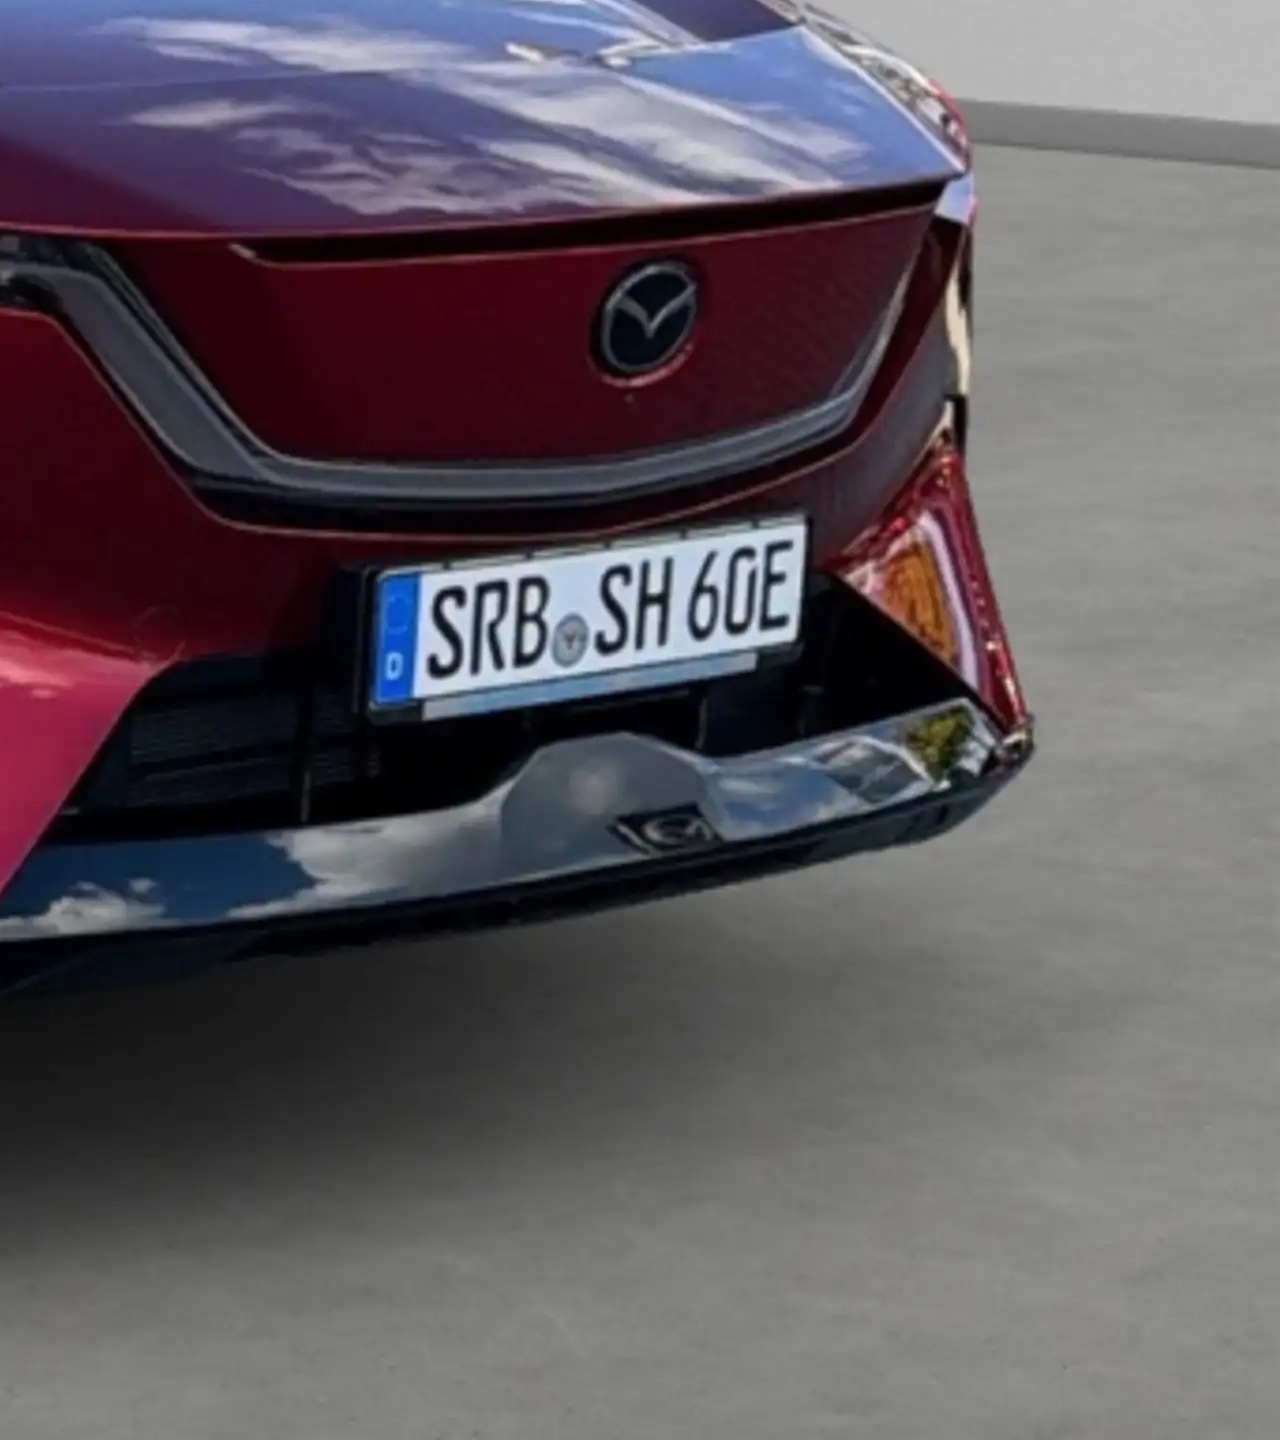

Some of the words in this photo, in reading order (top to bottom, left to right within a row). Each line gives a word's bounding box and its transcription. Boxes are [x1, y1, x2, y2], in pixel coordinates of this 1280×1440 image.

[426, 576, 551, 680] SRB
[595, 555, 674, 656] SH
[687, 539, 795, 643] 60E
[385, 651, 404, 681] D
